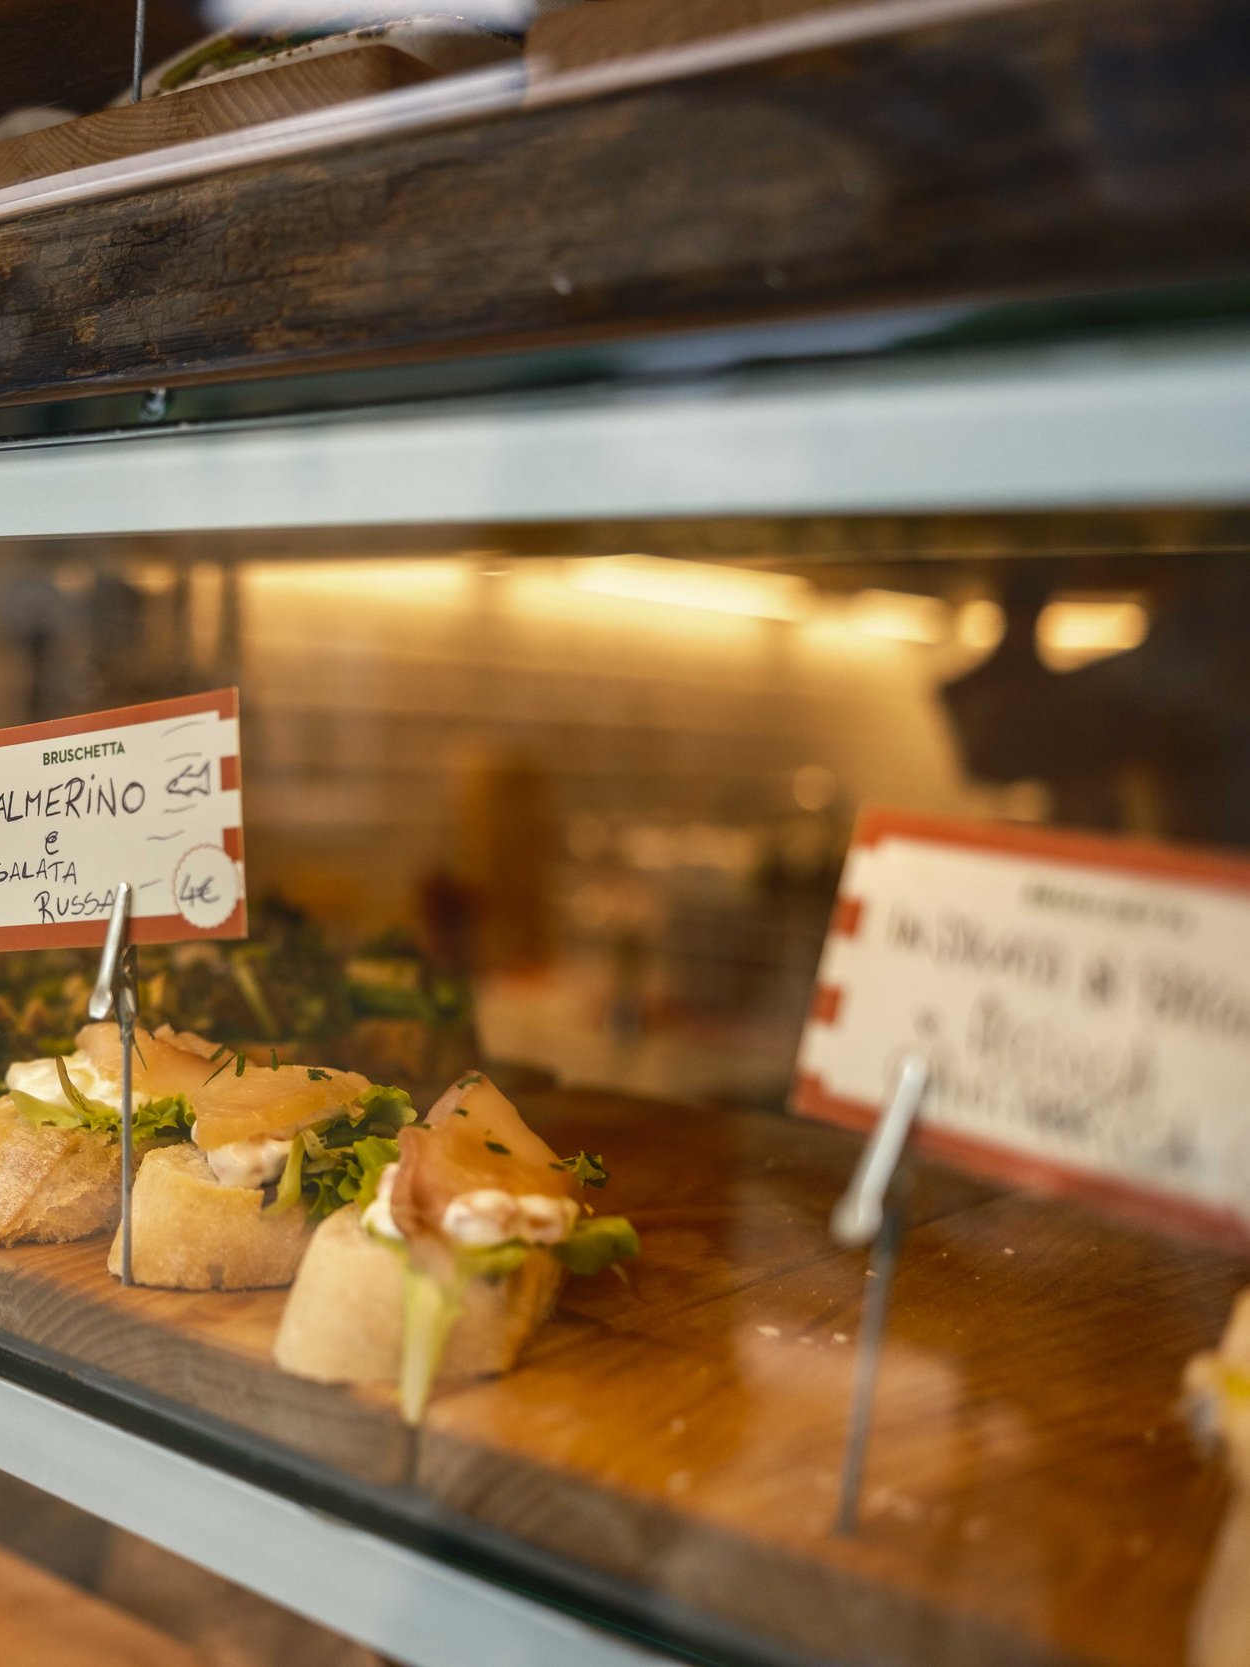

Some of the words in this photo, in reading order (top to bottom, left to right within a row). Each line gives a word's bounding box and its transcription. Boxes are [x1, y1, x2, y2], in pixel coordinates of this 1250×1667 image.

[42, 741, 126, 766] BRUSCHETTA
[34, 890, 117, 924] RUSSA
[180, 872, 220, 908] 4€
